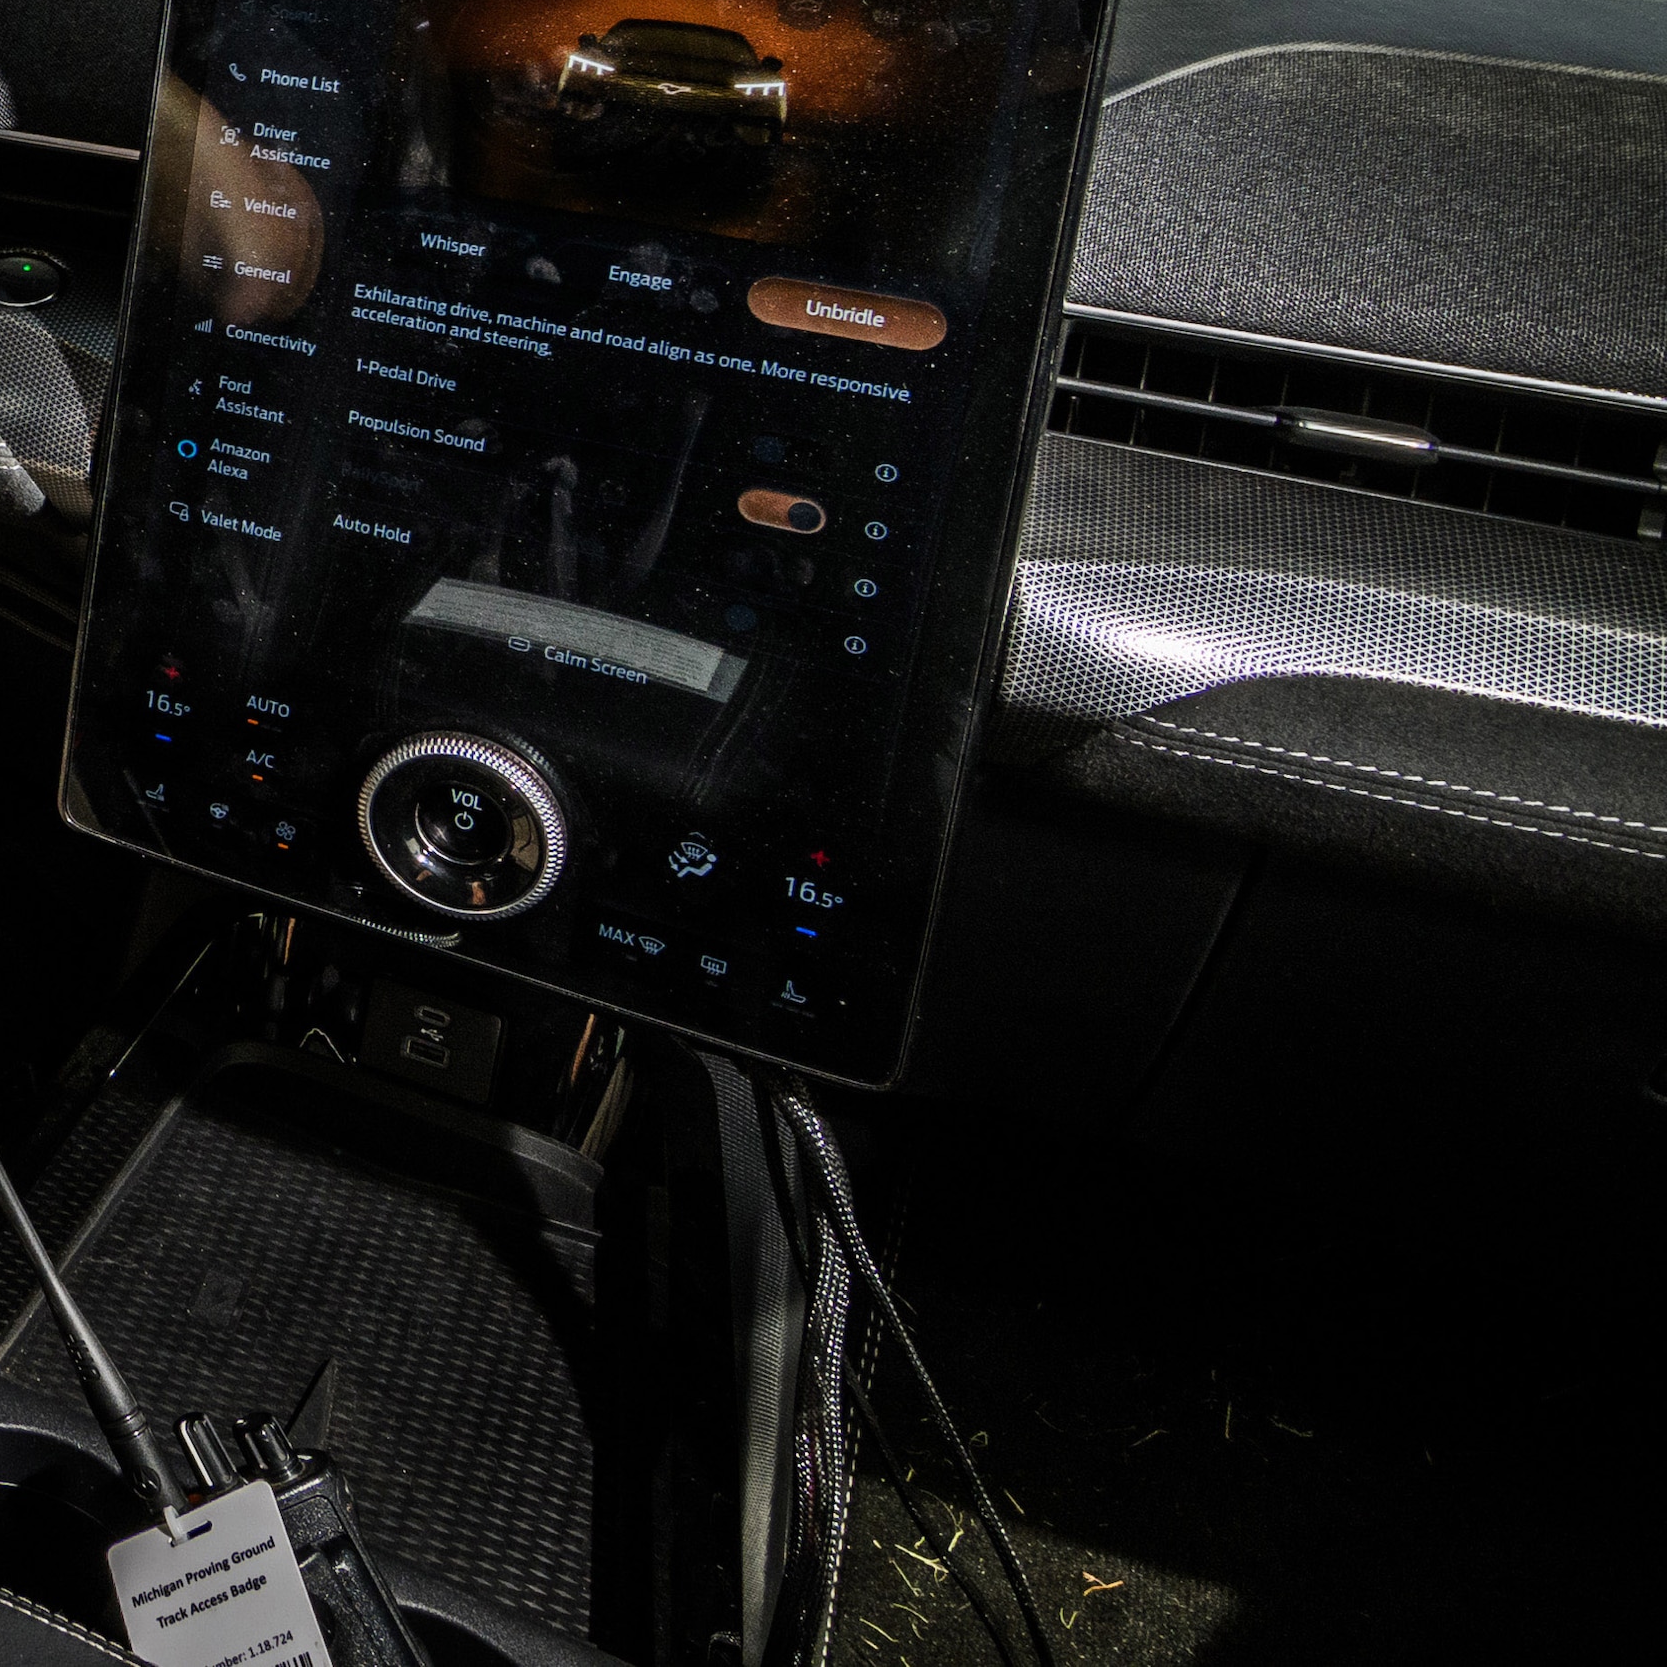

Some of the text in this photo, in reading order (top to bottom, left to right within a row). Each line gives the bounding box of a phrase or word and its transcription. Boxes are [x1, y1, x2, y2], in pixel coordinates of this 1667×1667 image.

[260, 68, 341, 94] Phone List
[253, 122, 298, 142] Driver
[249, 144, 331, 170] Assistance
[243, 196, 297, 219] Vehicle
[420, 232, 487, 257] Whisper
[234, 259, 291, 284] General
[608, 265, 673, 291] Engage
[350, 306, 447, 335] acceleration
[449, 325, 481, 341] and
[805, 299, 886, 328] Unbridle
[225, 323, 317, 357] Connectivity
[353, 283, 448, 317] Exhilarating
[449, 301, 493, 325] drive,
[496, 313, 567, 337] machine
[569, 327, 604, 344] and
[605, 334, 646, 352] road
[647, 339, 691, 361] align
[693, 350, 715, 365] as
[718, 355, 756, 373] one.
[760, 359, 807, 382] More
[218, 375, 252, 395] Ford
[356, 357, 457, 392] 1-Pedal Drive
[215, 396, 285, 424] Assistant
[348, 409, 486, 452] Propulsion Sound
[209, 438, 271, 464] Amazon
[206, 458, 248, 480] Alexa
[201, 509, 282, 542] Valet Mode
[332, 513, 411, 544] Auto Hold
[541, 642, 649, 687] Calm Screen
[246, 695, 290, 718] AUTO
[245, 749, 275, 769] A/C
[451, 788, 482, 811] VOL
[598, 923, 636, 947] MAX
[131, 1535, 276, 1609] Michigan Proving Ground
[155, 1575, 267, 1629] Track Access Badge
[248, 1629, 294, 1659] 1.18.724
